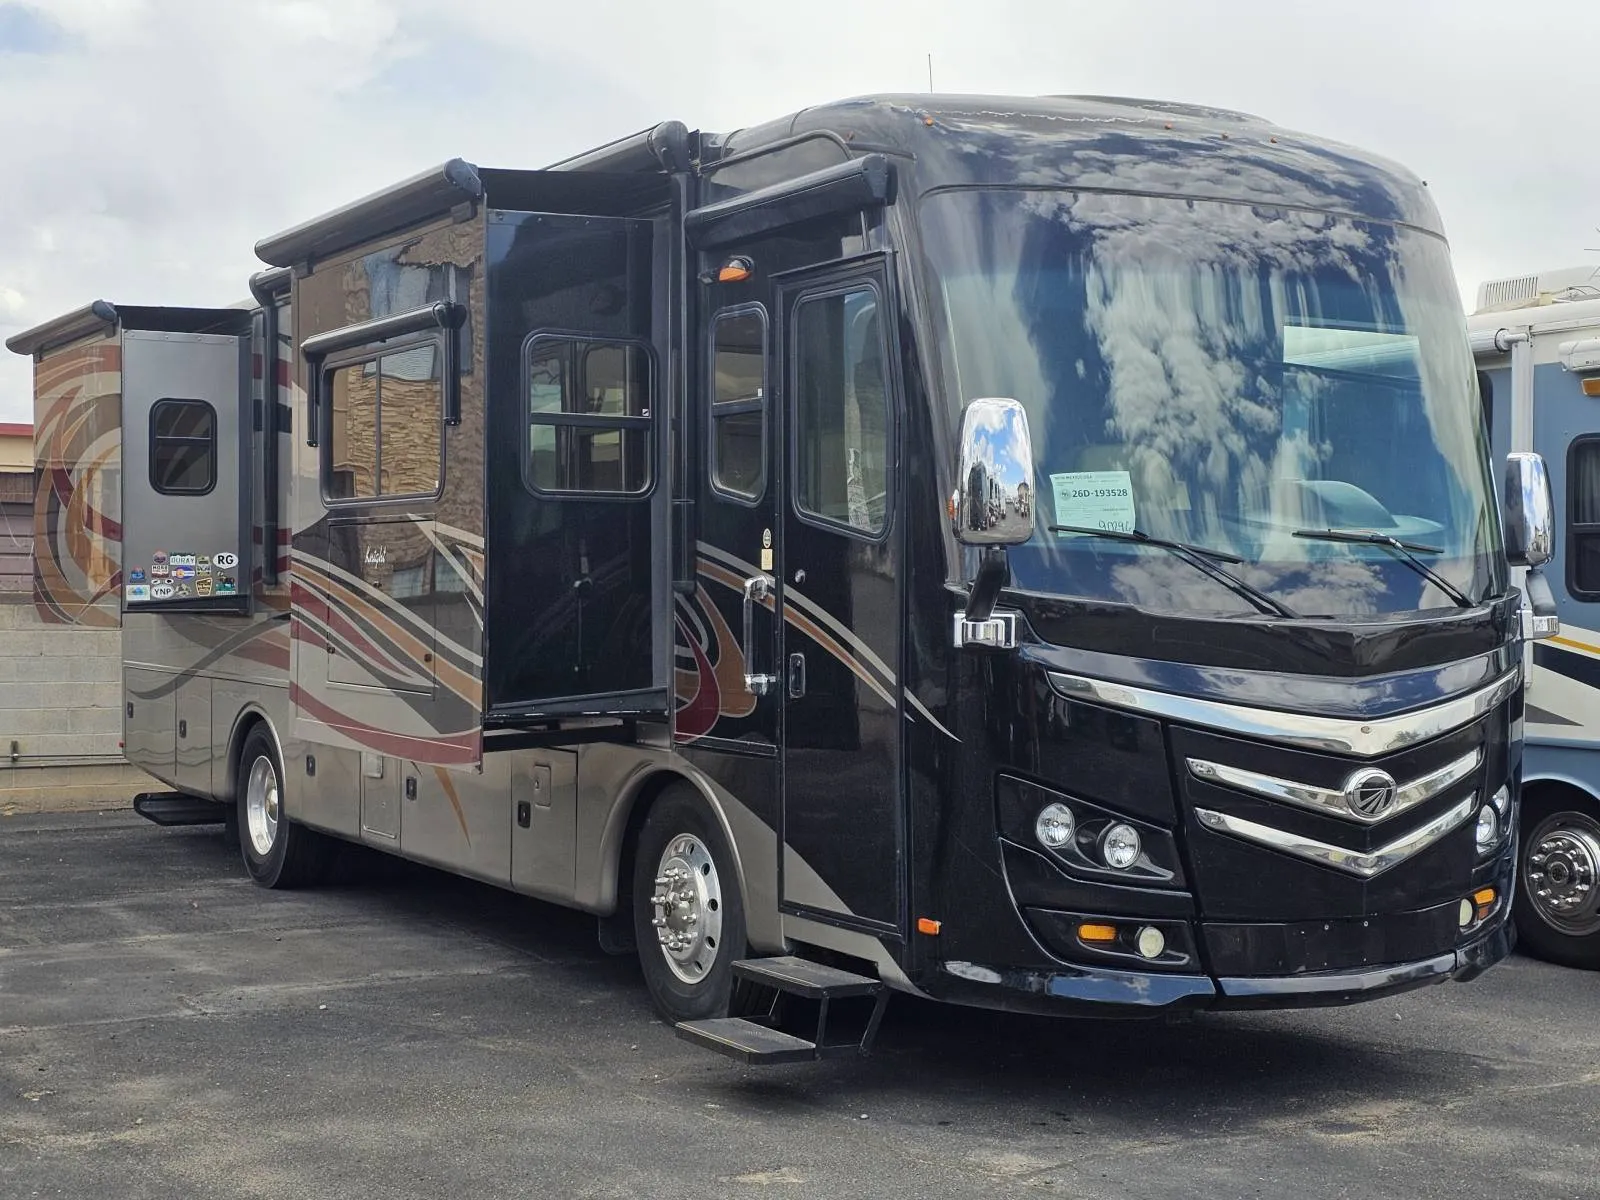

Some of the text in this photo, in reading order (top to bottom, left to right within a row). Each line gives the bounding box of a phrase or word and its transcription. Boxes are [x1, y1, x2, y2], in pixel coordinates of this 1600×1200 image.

[1072, 488, 1128, 497] 26D-193528
[217, 555, 234, 565] RG
[154, 588, 172, 596] YNP
